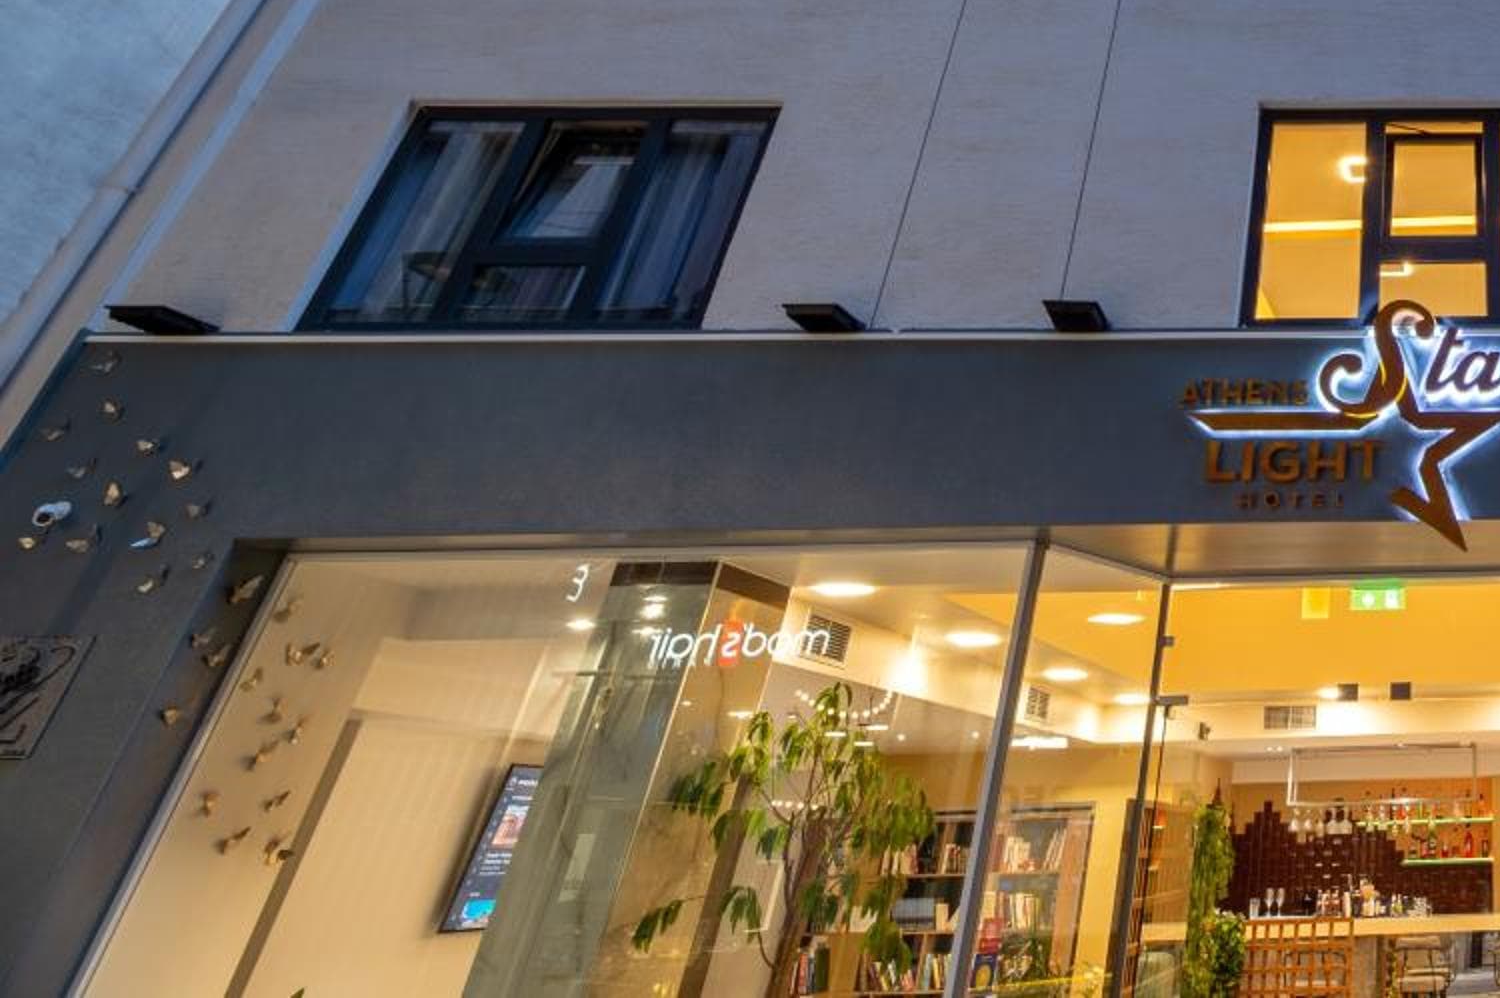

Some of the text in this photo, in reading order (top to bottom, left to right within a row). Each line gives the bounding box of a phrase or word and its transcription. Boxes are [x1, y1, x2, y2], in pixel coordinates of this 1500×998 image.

[1184, 378, 1309, 406] ATHENS
[1207, 440, 1383, 482] LIGHT
[1235, 489, 1344, 507] HOTEL
